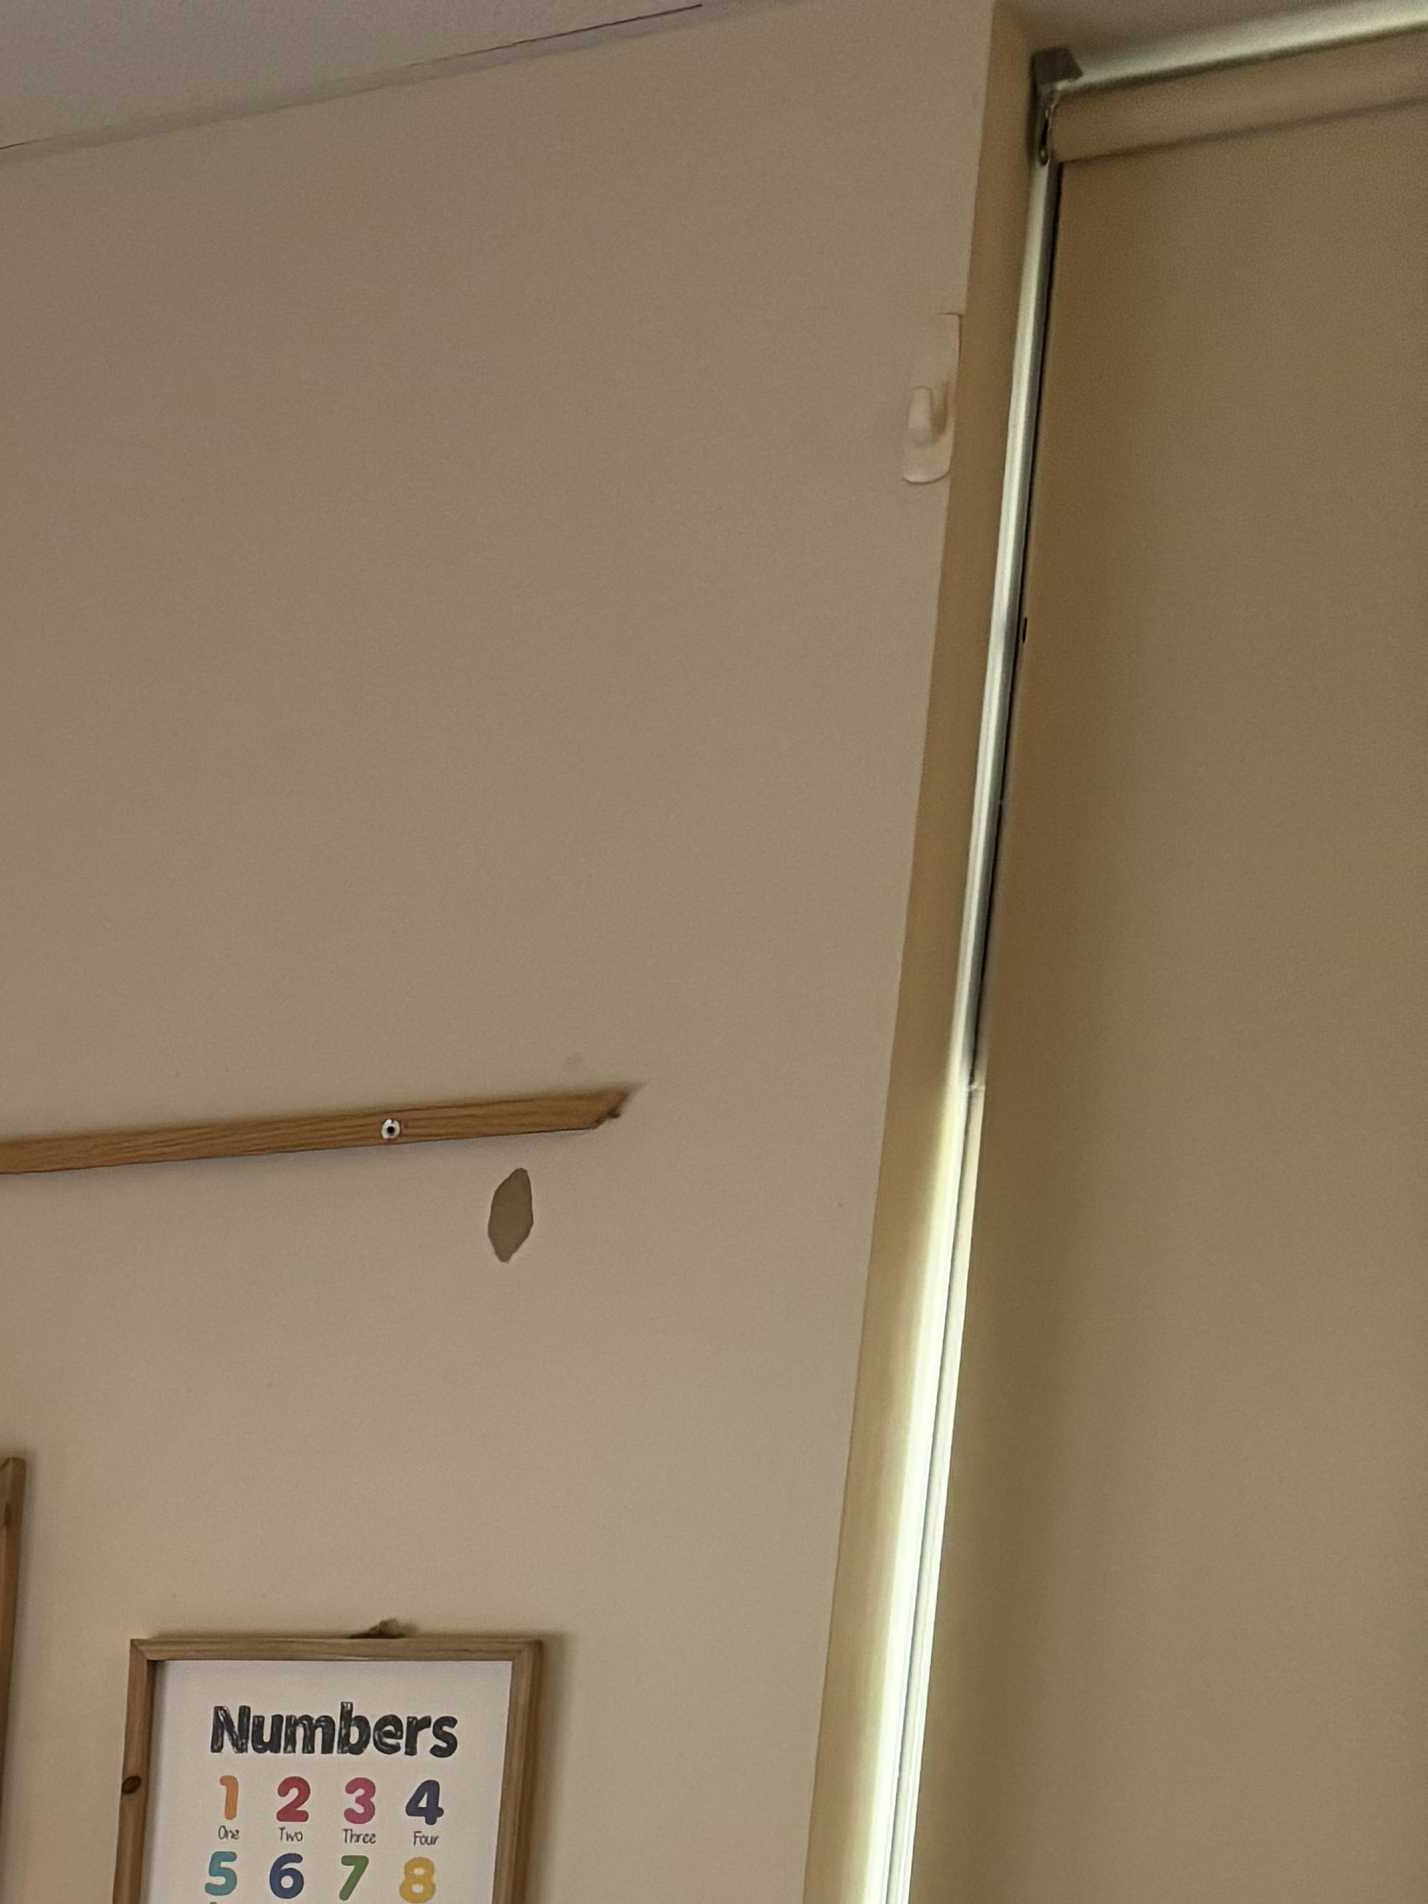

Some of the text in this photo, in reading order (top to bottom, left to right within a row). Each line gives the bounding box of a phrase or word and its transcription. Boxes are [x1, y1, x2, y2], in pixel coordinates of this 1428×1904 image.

[210, 1702, 458, 1758] Numbers
[219, 1775, 444, 1826] 1 2 3 4
[218, 1825, 439, 1847] One Two Three Four
[204, 1851, 436, 1904] 5 6 7 8
